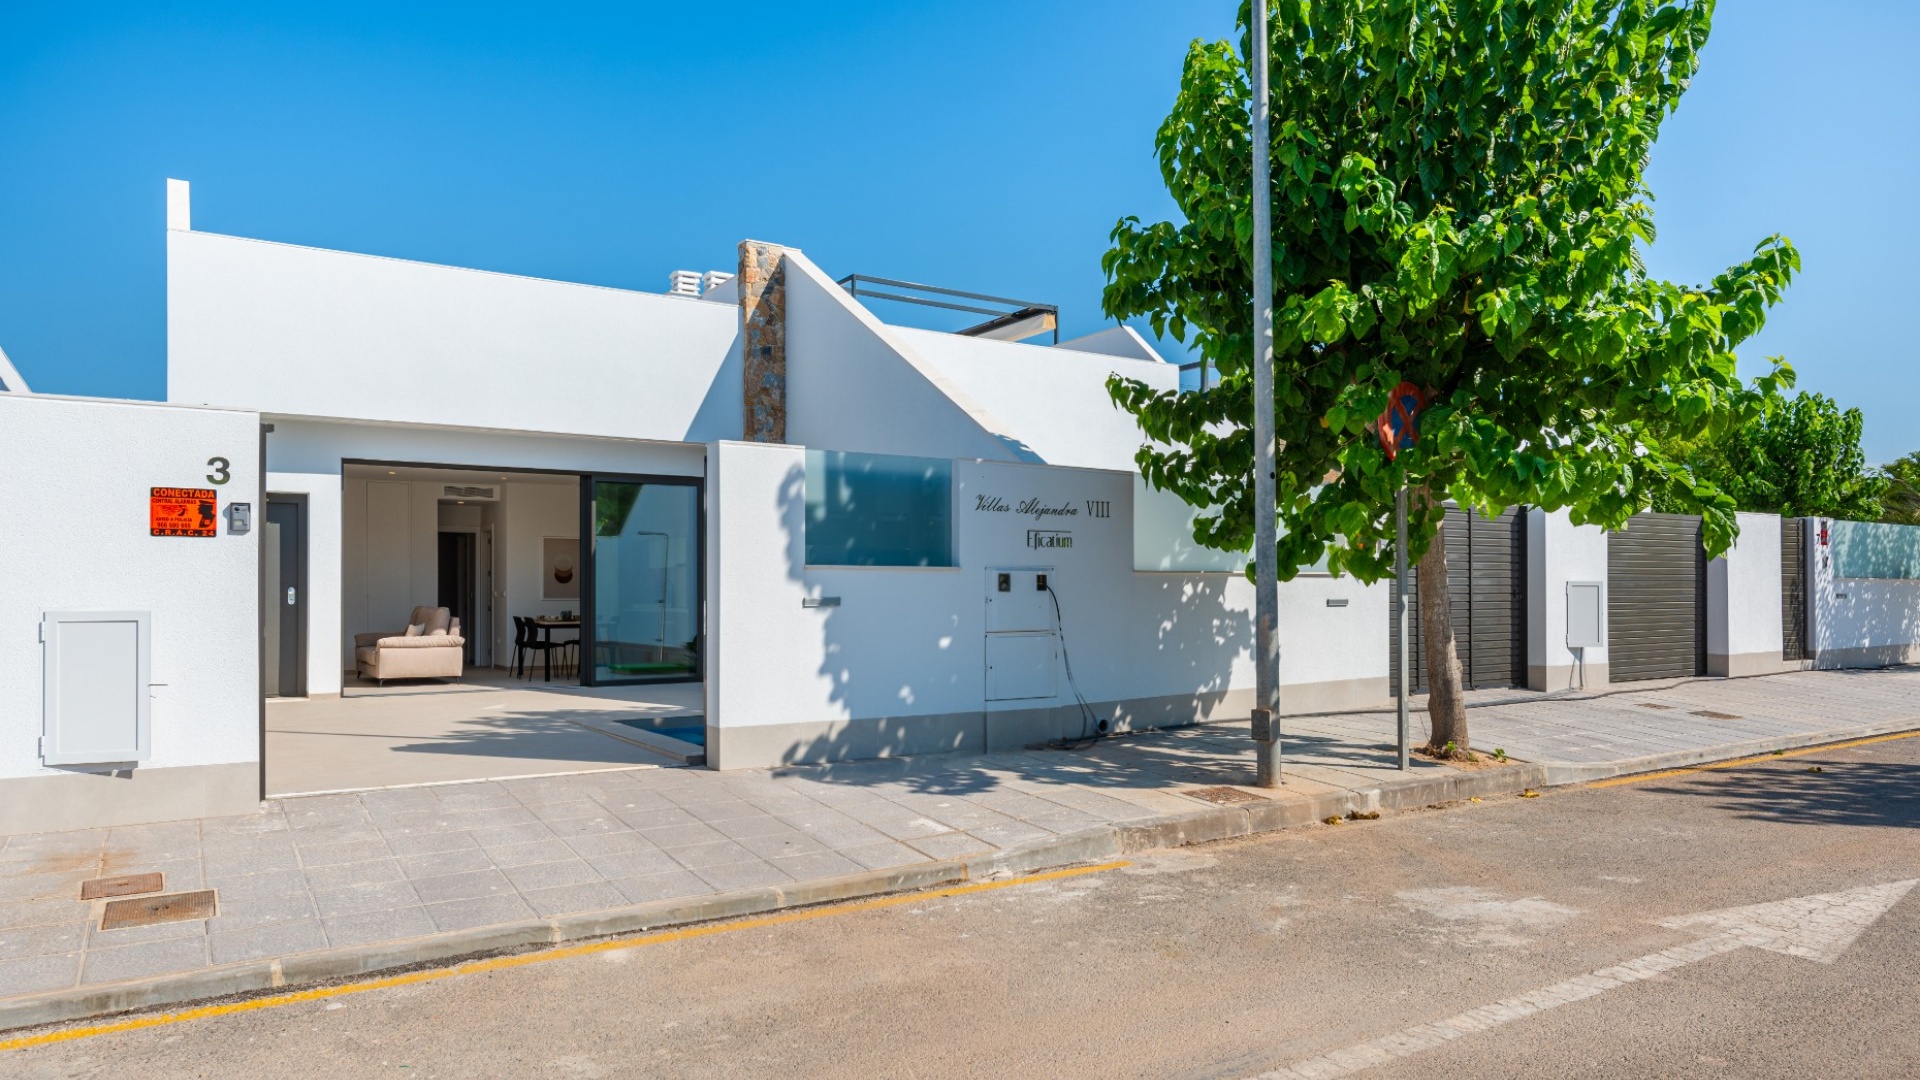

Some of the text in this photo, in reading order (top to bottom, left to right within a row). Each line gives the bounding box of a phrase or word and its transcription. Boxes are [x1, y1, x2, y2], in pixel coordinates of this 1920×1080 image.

[206, 456, 231, 485] 3
[153, 488, 215, 498] CONECTADA
[974, 494, 1111, 521] Villas Alejandra VIII
[1026, 529, 1073, 550] Eficatium
